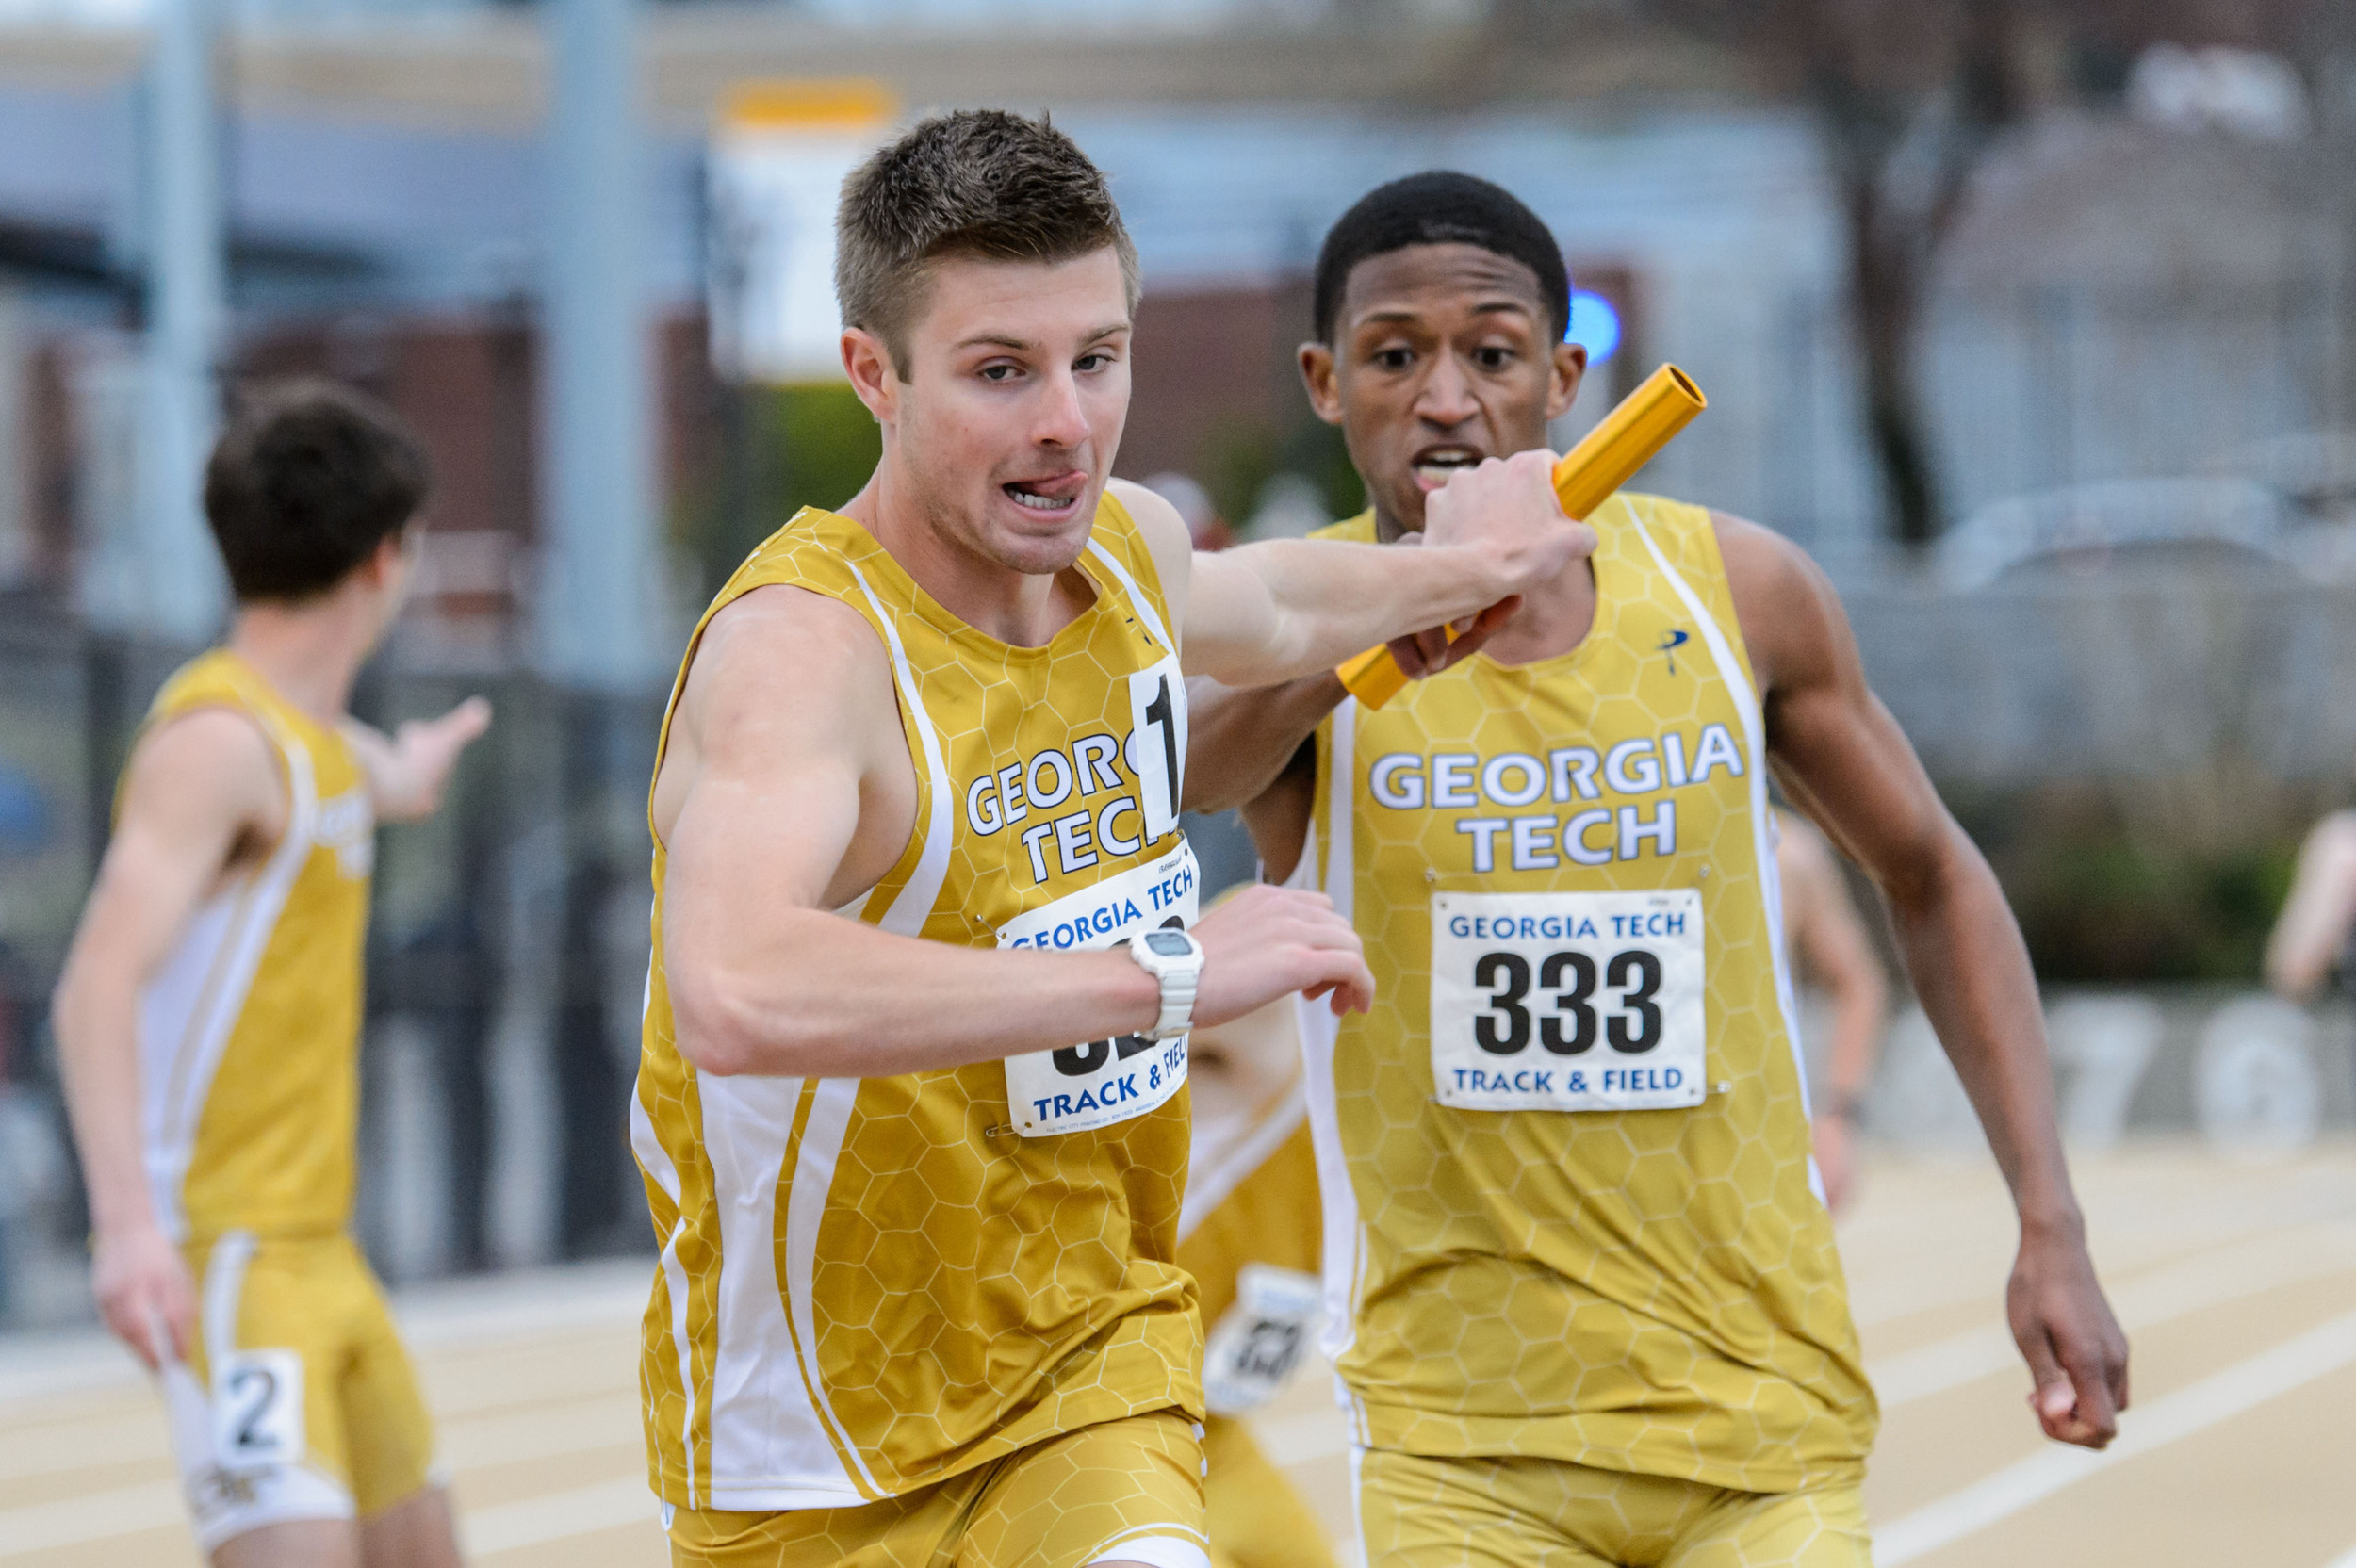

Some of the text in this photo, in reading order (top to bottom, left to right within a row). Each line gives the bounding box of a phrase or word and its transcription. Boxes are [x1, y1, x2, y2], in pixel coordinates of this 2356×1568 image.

[1144, 672, 1179, 819] 1
[1369, 722, 1744, 810] GEORGIA
[1022, 795, 1170, 884] TEC
[1455, 799, 1676, 873] TECH
[1148, 863, 1193, 912] TECH
[1449, 912, 1686, 939] GEORGIA TECH
[1475, 949, 1662, 1055] 333
[1033, 1072, 1140, 1122] TRACK
[1150, 1064, 1161, 1090] &
[1453, 1067, 1683, 1094] TRACK & FIELD
[230, 1368, 279, 1447] 2
